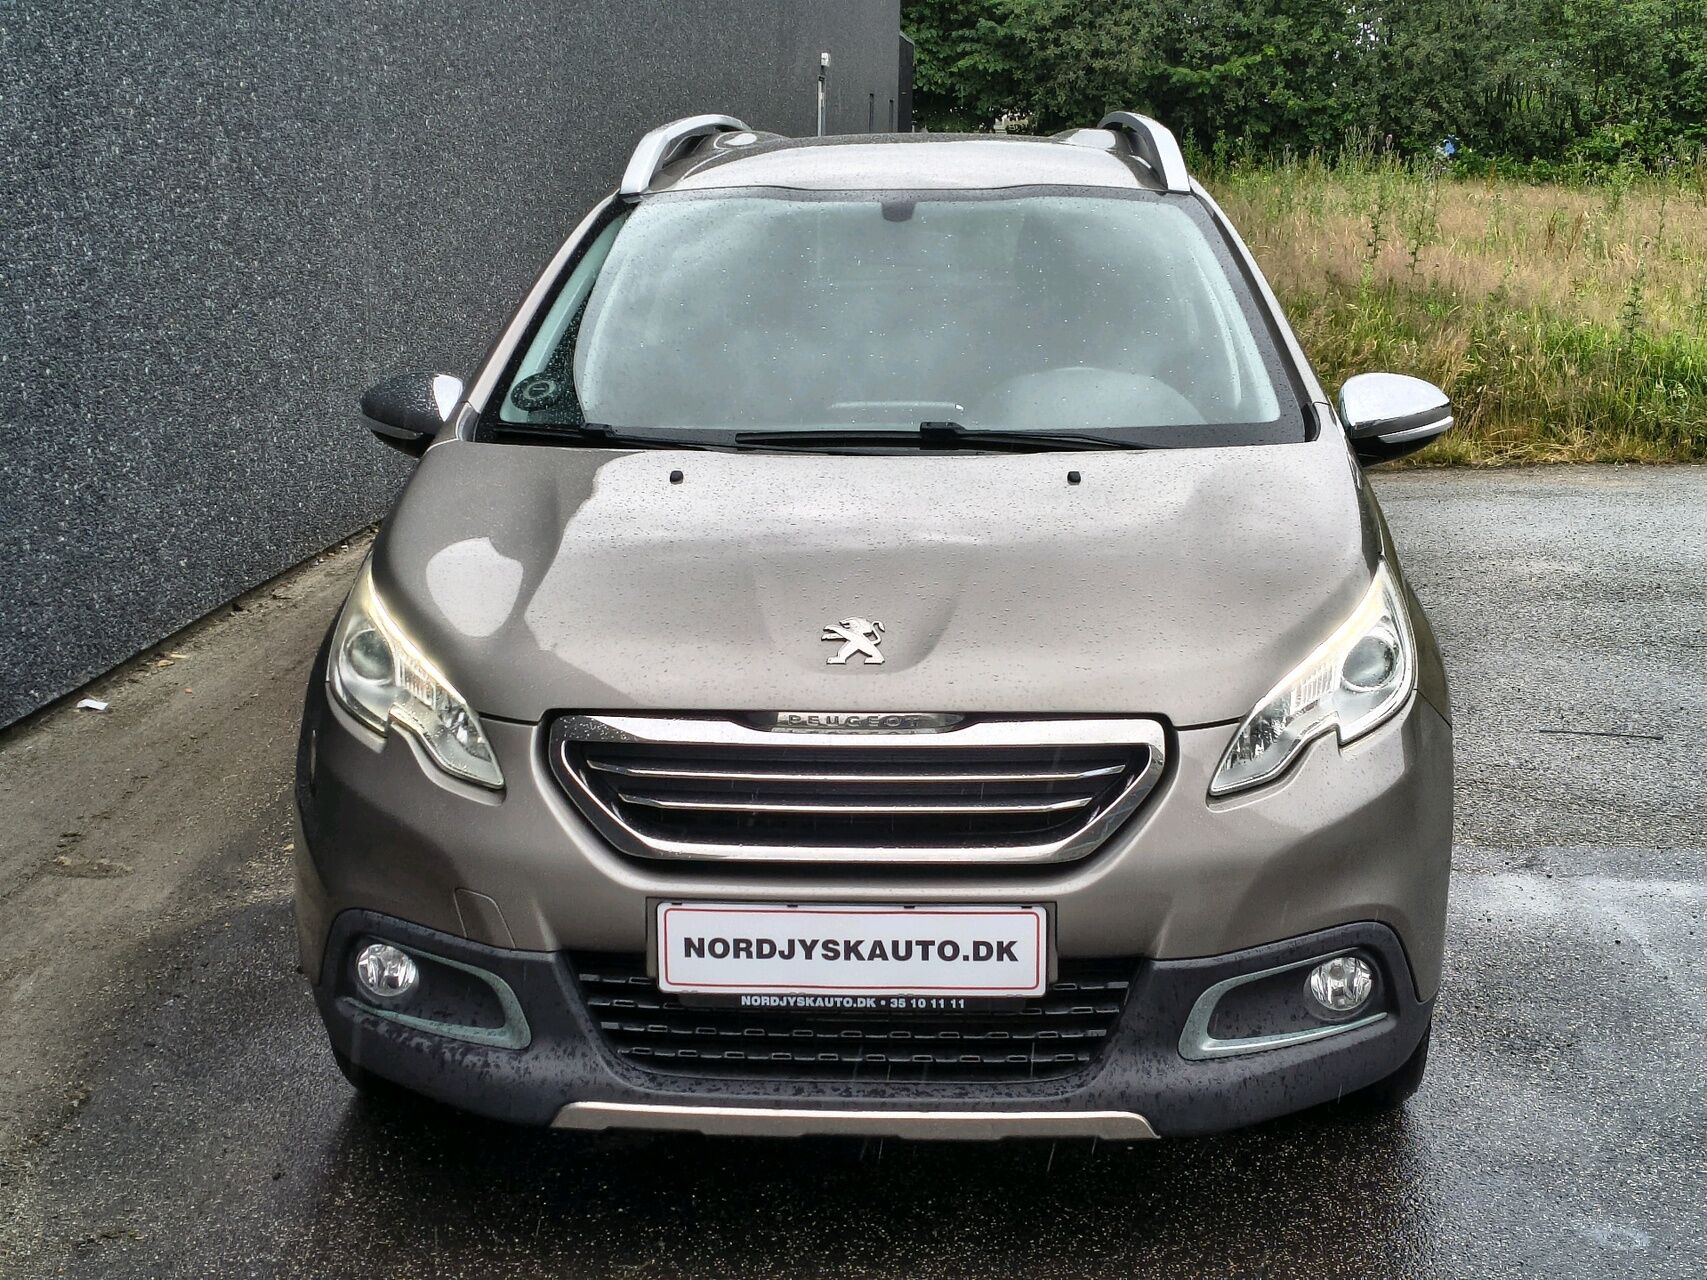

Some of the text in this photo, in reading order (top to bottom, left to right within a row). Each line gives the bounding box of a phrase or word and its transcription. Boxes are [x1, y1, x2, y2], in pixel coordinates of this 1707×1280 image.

[788, 714, 921, 728] PEUGEOT
[683, 937, 1019, 963] NORDJYSKAUTO.DK
[741, 995, 965, 1009] NORDJYSKAUTO.DK 35 10 11 11
